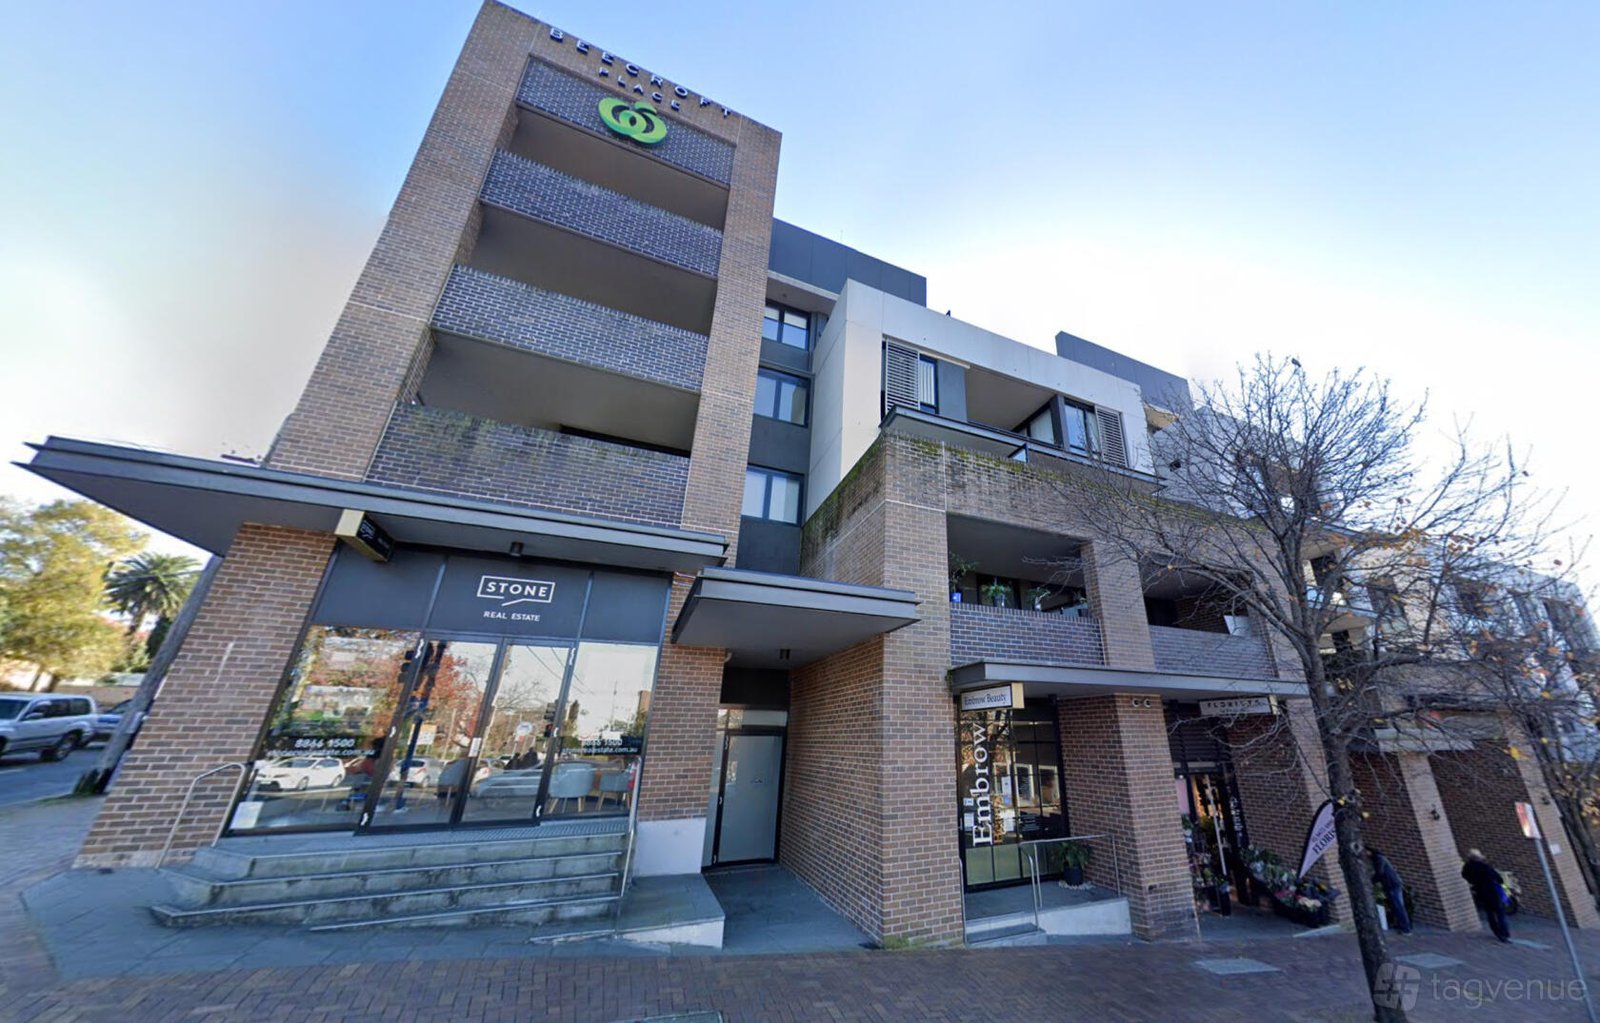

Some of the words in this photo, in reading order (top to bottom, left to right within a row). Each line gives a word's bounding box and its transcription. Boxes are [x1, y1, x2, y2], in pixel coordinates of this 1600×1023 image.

[549, 27, 731, 118] BEECROFT
[598, 67, 681, 111] PLACE
[484, 581, 548, 597] STONE
[483, 611, 507, 620] REAL
[511, 612, 540, 622] ESTATE
[986, 693, 1008, 704] Beauty
[971, 723, 993, 847] Embrow
[1312, 829, 1336, 855] FLORIS
